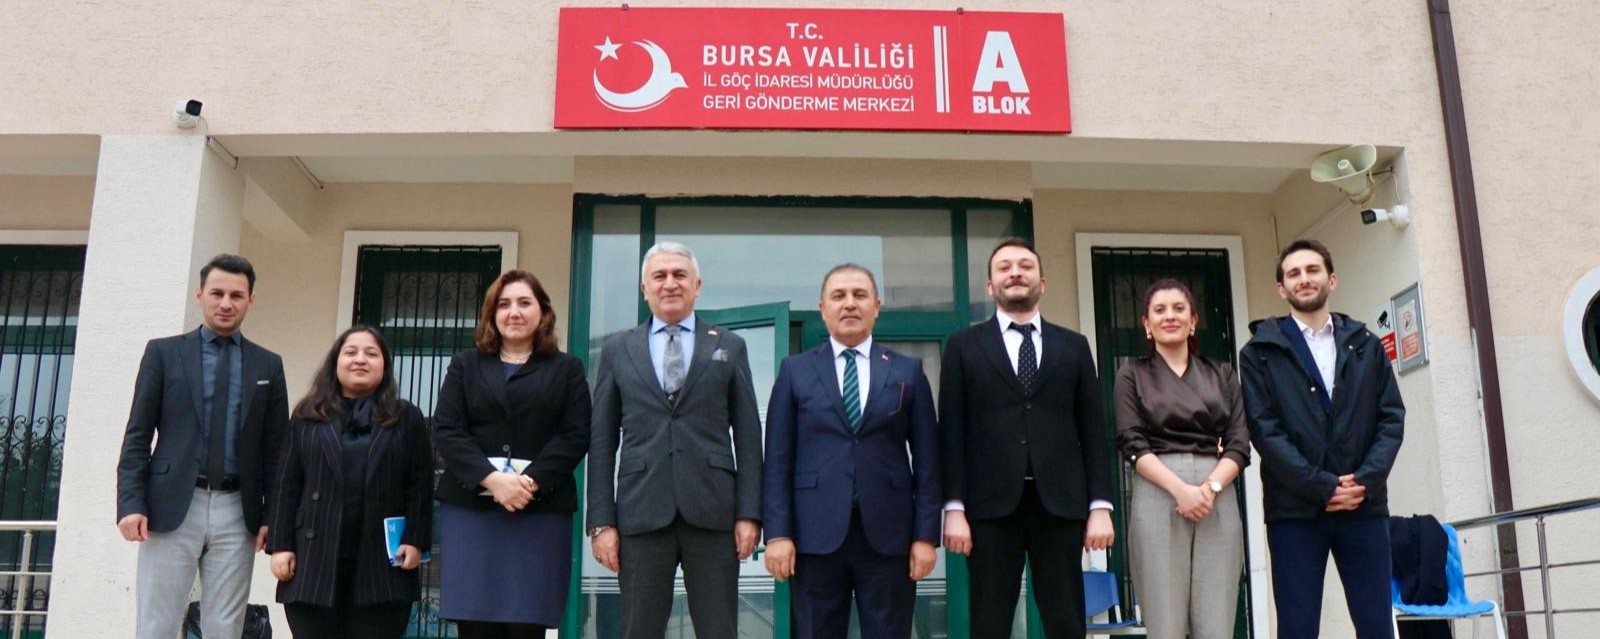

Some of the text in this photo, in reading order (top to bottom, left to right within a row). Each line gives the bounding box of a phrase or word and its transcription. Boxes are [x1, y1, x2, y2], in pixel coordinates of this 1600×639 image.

[786, 23, 824, 40] T.C.
[703, 42, 914, 69] BURSA VALİLİĞİ
[972, 30, 1030, 94] A
[703, 72, 914, 91] İL GÖÇ İDARESİ MÜDÜRLÜĞÜ
[703, 93, 915, 112] GERİ GÖNDERME MERKEZİ
[972, 95, 1031, 115] BLOK
